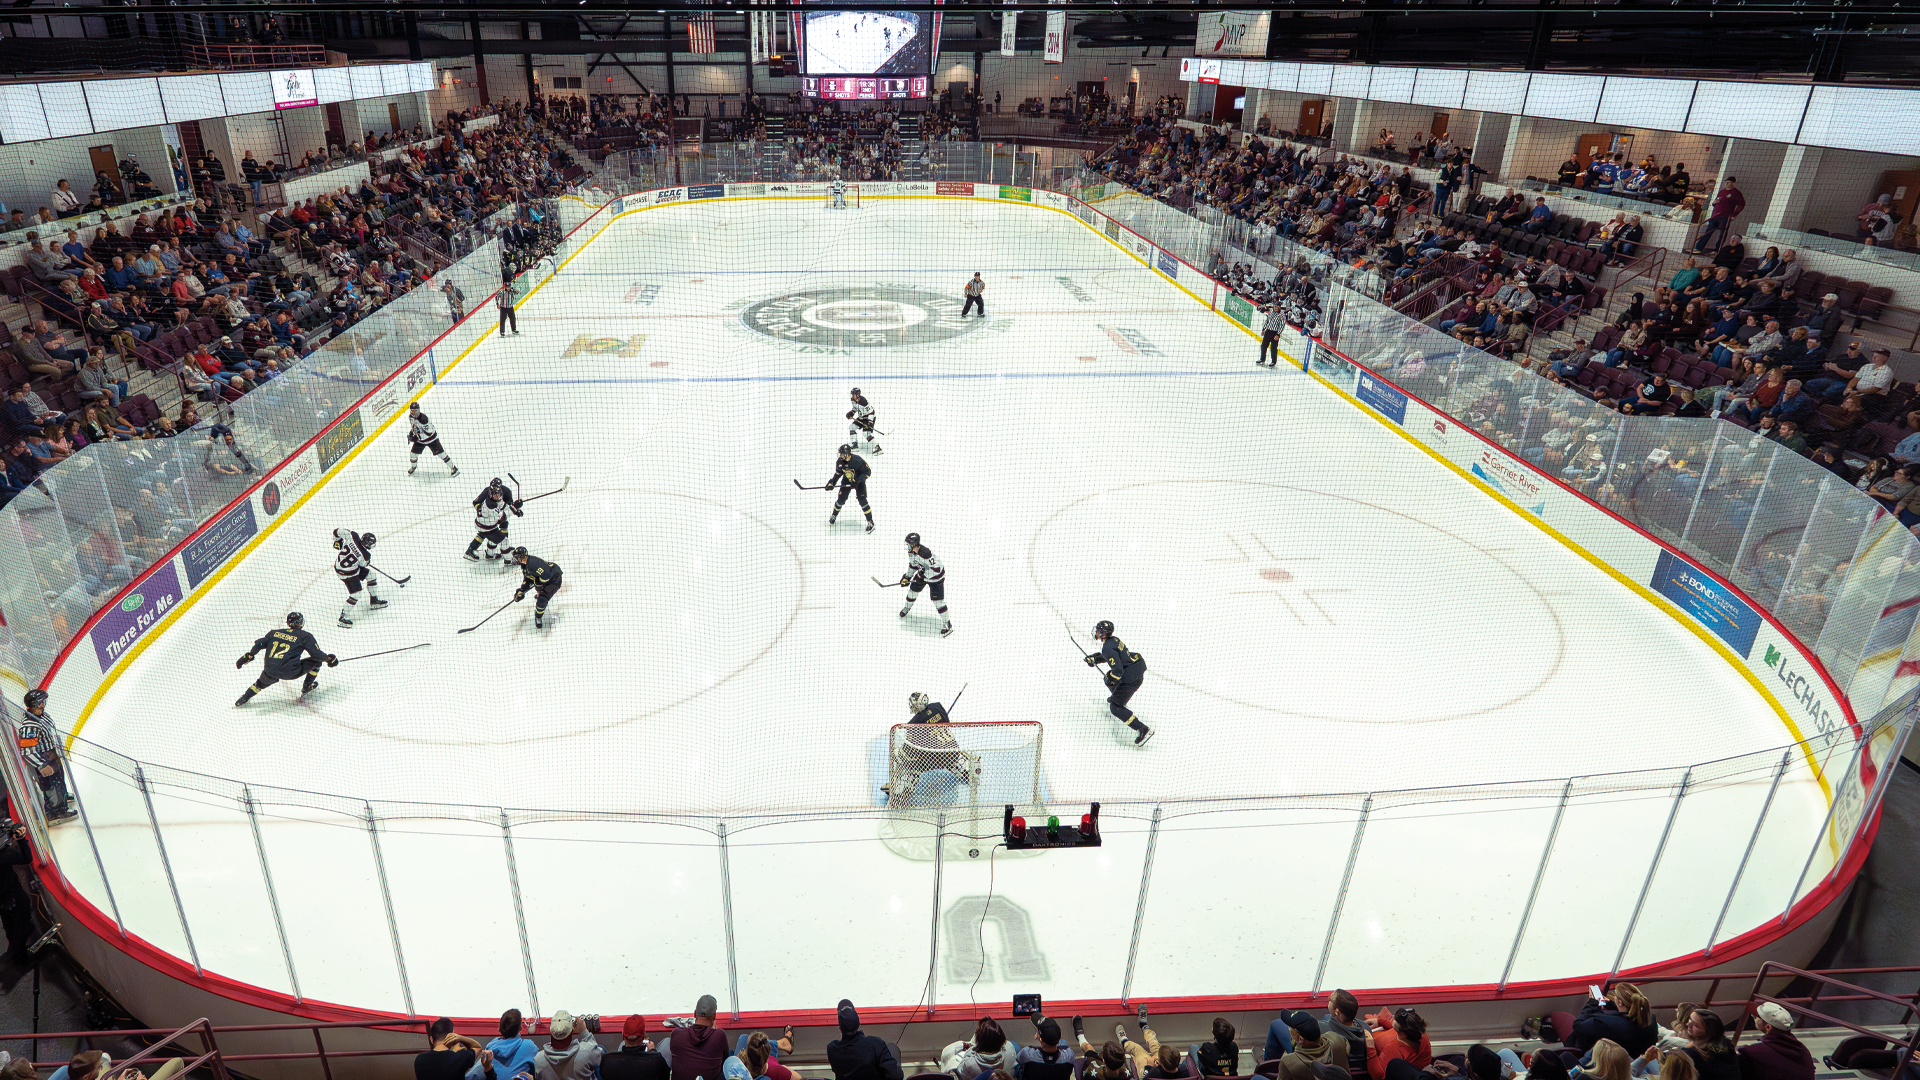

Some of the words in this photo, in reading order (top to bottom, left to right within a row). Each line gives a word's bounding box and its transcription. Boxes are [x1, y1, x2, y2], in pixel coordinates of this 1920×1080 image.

[1048, 33, 1060, 53] 2014
[1225, 24, 1246, 44] MVP
[884, 80, 889, 92] 1
[658, 189, 682, 198] ECAC
[327, 449, 344, 467] IRISH
[346, 436, 358, 448] PUB
[280, 458, 313, 490] Marcella's
[1491, 458, 1518, 481] Garnet
[1519, 474, 1540, 494] River
[190, 546, 205, 560] R.A.
[220, 524, 232, 537] Law
[231, 510, 248, 527] Group
[338, 545, 358, 568] 28
[928, 557, 936, 566] 12
[1688, 577, 1715, 600] BOND
[105, 627, 136, 660] There
[137, 612, 155, 632] For
[156, 593, 174, 615] Me
[269, 641, 290, 659] 12
[1109, 657, 1116, 666] 2
[944, 895, 1051, 984] U
